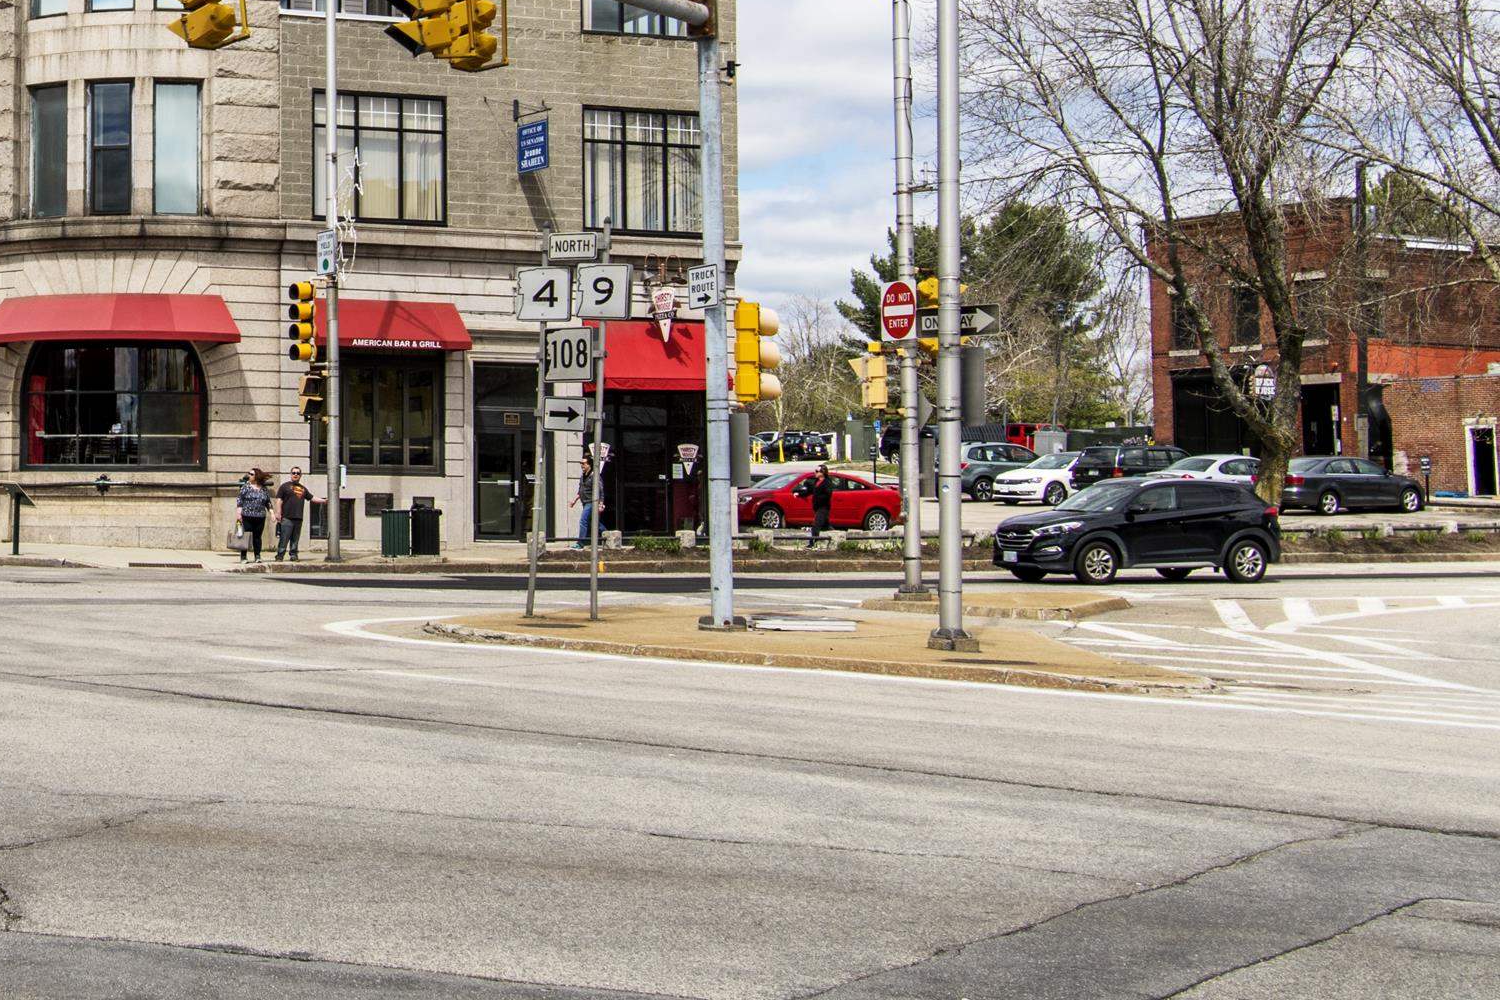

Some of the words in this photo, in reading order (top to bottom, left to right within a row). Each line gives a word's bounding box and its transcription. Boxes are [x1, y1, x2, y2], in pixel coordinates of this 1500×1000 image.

[521, 156, 545, 169] SHAHEEN
[555, 239, 590, 253] NORTH
[691, 269, 715, 281] TRUCK
[532, 279, 558, 308] 4
[592, 277, 614, 306] 9
[691, 282, 715, 293] ROUTE
[886, 294, 895, 303] DO
[898, 292, 911, 301] NOT
[888, 318, 909, 329] ENTER
[352, 338, 392, 347] AMERICAN
[551, 338, 588, 369] 108
